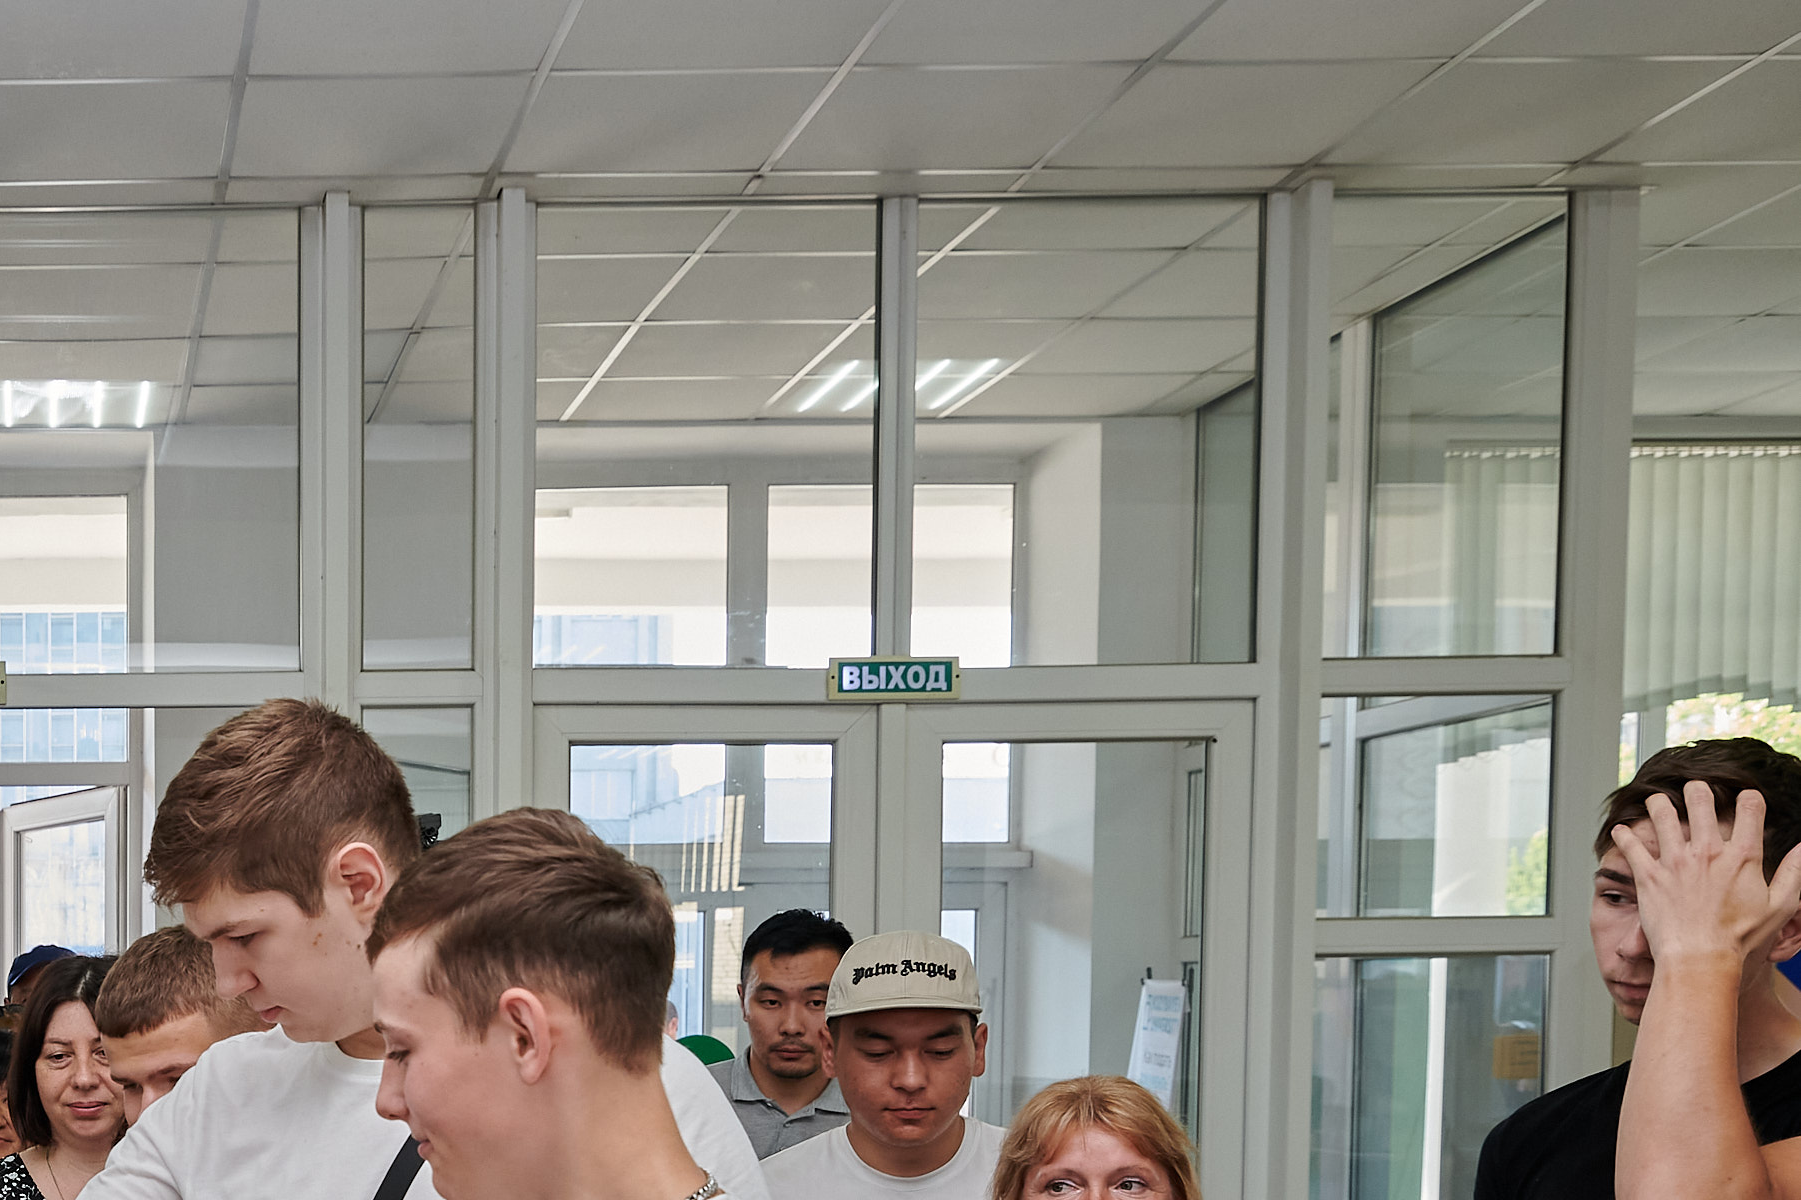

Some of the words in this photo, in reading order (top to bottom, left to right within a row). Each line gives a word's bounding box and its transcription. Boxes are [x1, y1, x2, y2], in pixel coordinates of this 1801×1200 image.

[841, 664, 948, 691] ВЫХОД
[852, 962, 898, 985] Palm
[900, 959, 957, 981] Angels
